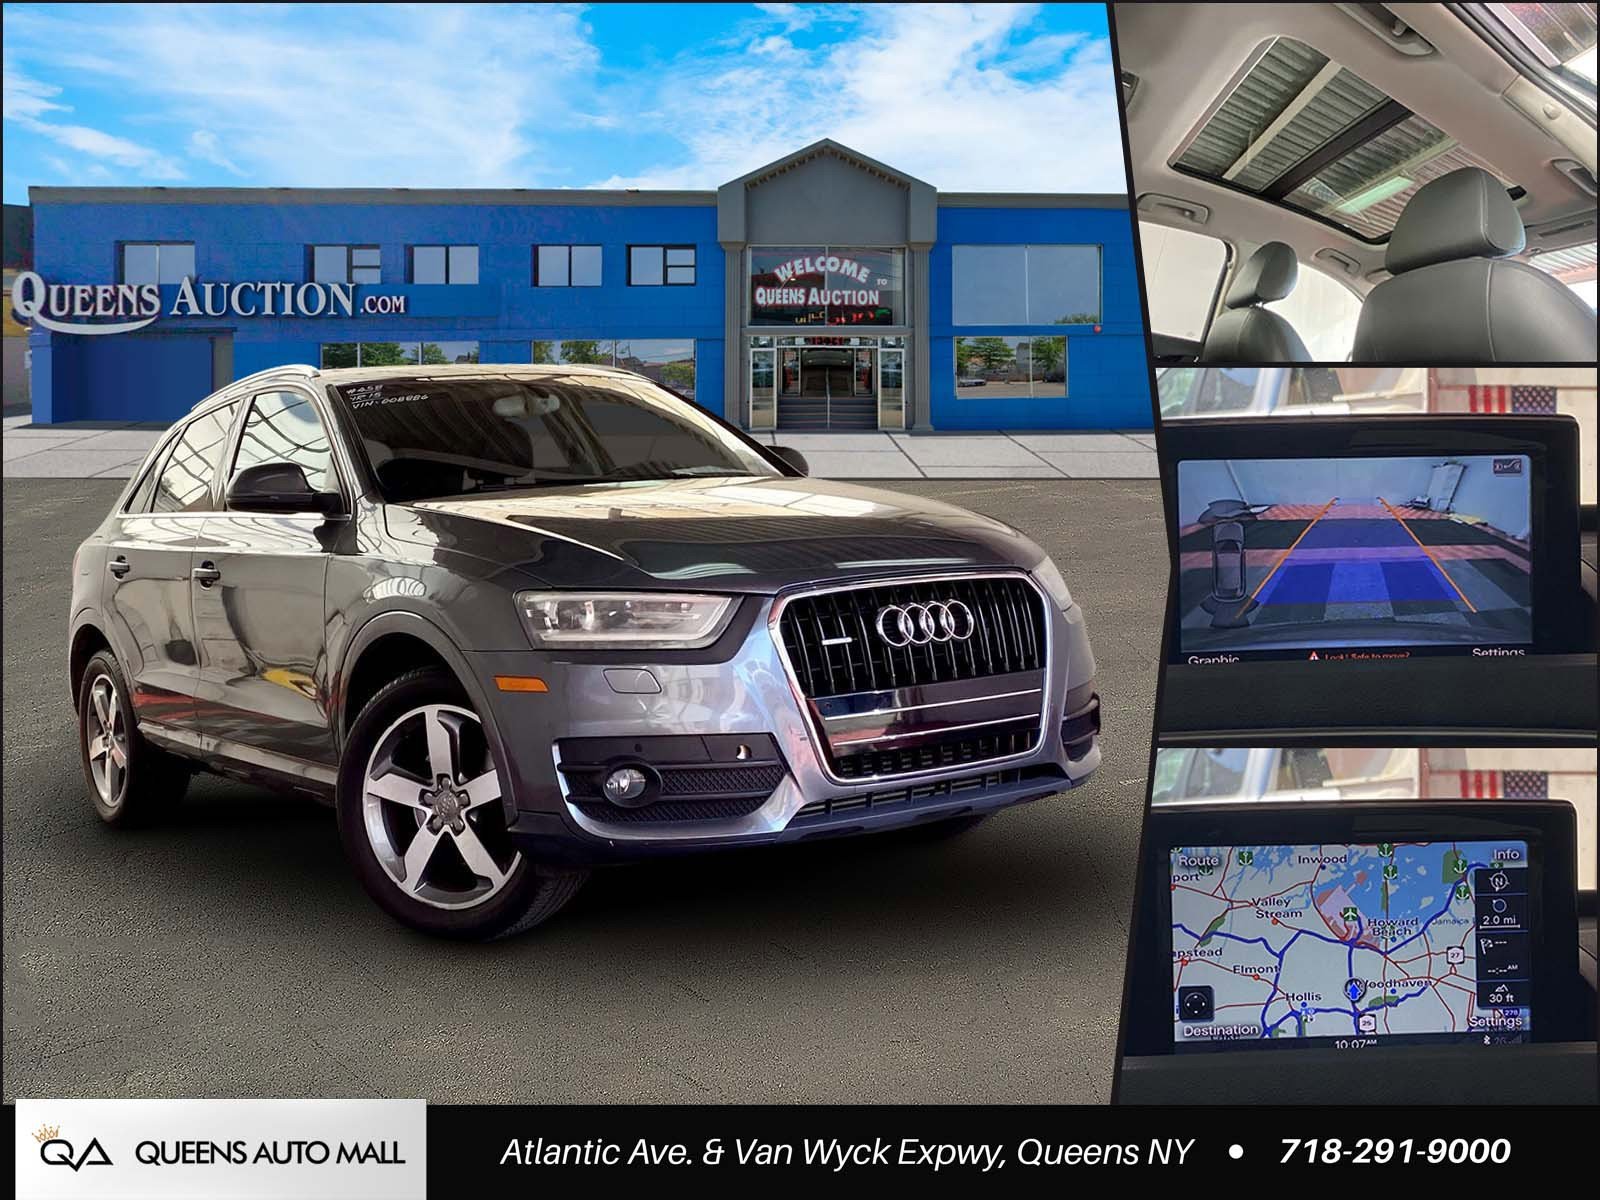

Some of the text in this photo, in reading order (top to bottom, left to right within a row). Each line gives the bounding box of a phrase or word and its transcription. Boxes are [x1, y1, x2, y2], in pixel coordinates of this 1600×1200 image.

[774, 256, 888, 286] WELCOME TO
[755, 287, 880, 306] QUEENS AUCTION
[11, 271, 161, 335] QUEENS
[1298, 854, 1348, 865] Inwood
[1493, 848, 1520, 860] Info
[1178, 855, 1219, 867] Route
[1251, 897, 1291, 908] Valley
[1255, 909, 1303, 919] Stream
[1367, 917, 1419, 927] Howard
[1483, 915, 1516, 925] 2.0 mi
[1232, 964, 1280, 975] Elmont
[1285, 992, 1322, 1002] Hollis
[1489, 993, 1514, 1003] 30 ft
[1469, 1016, 1523, 1029] Settings
[1183, 1025, 1259, 1037] Destination
